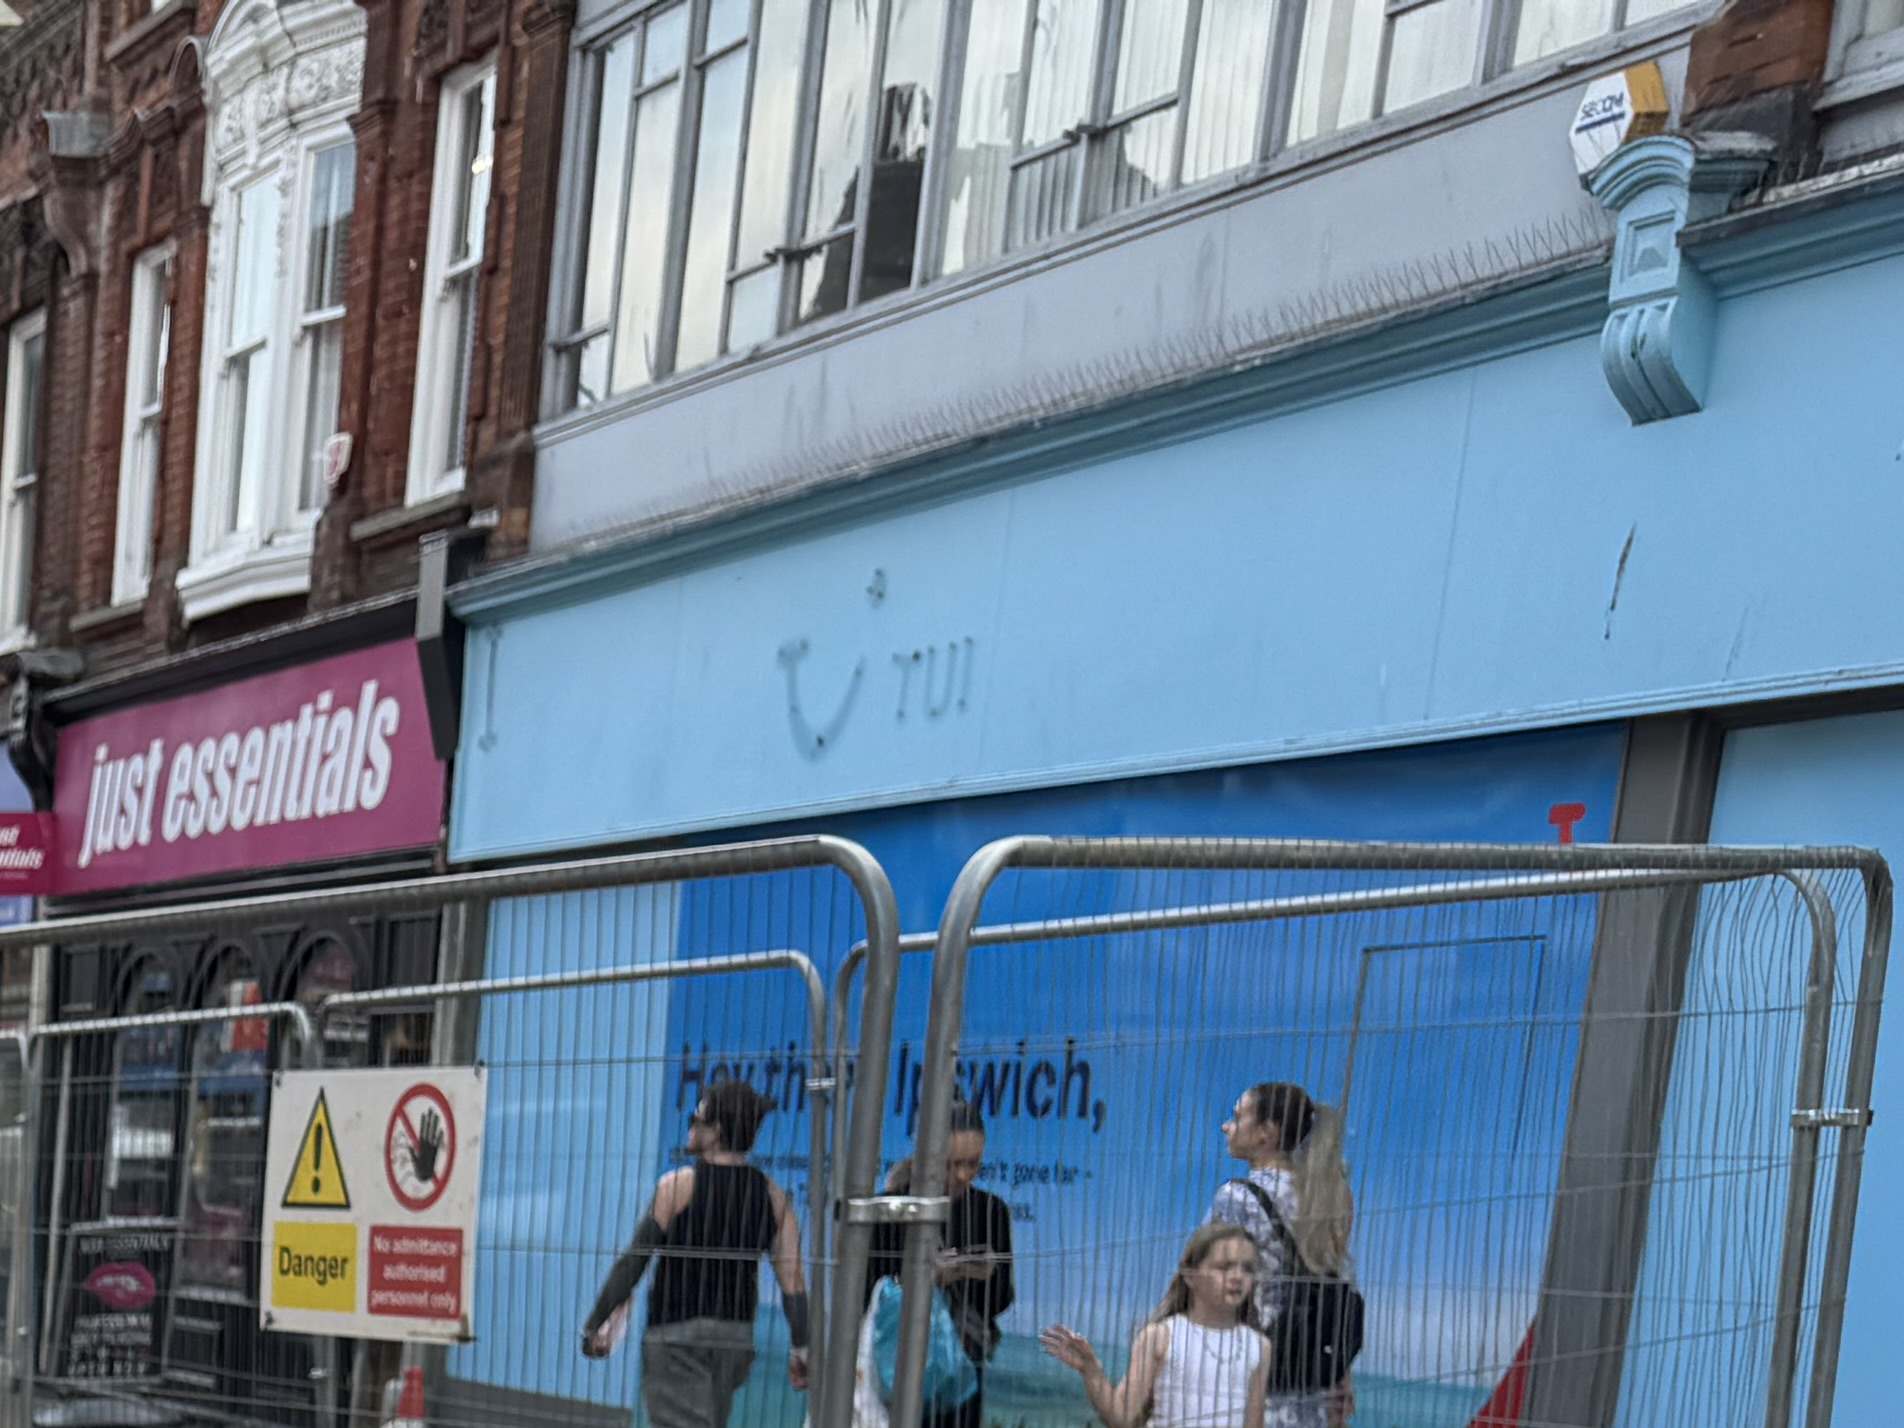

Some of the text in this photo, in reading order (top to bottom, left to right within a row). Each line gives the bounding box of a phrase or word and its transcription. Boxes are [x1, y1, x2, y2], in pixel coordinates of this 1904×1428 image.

[78, 679, 400, 866] just essentials
[373, 1234, 458, 1257] No admittance
[278, 1246, 348, 1286] Danger
[382, 1262, 446, 1283] authorised
[371, 1289, 457, 1315] personnel only
